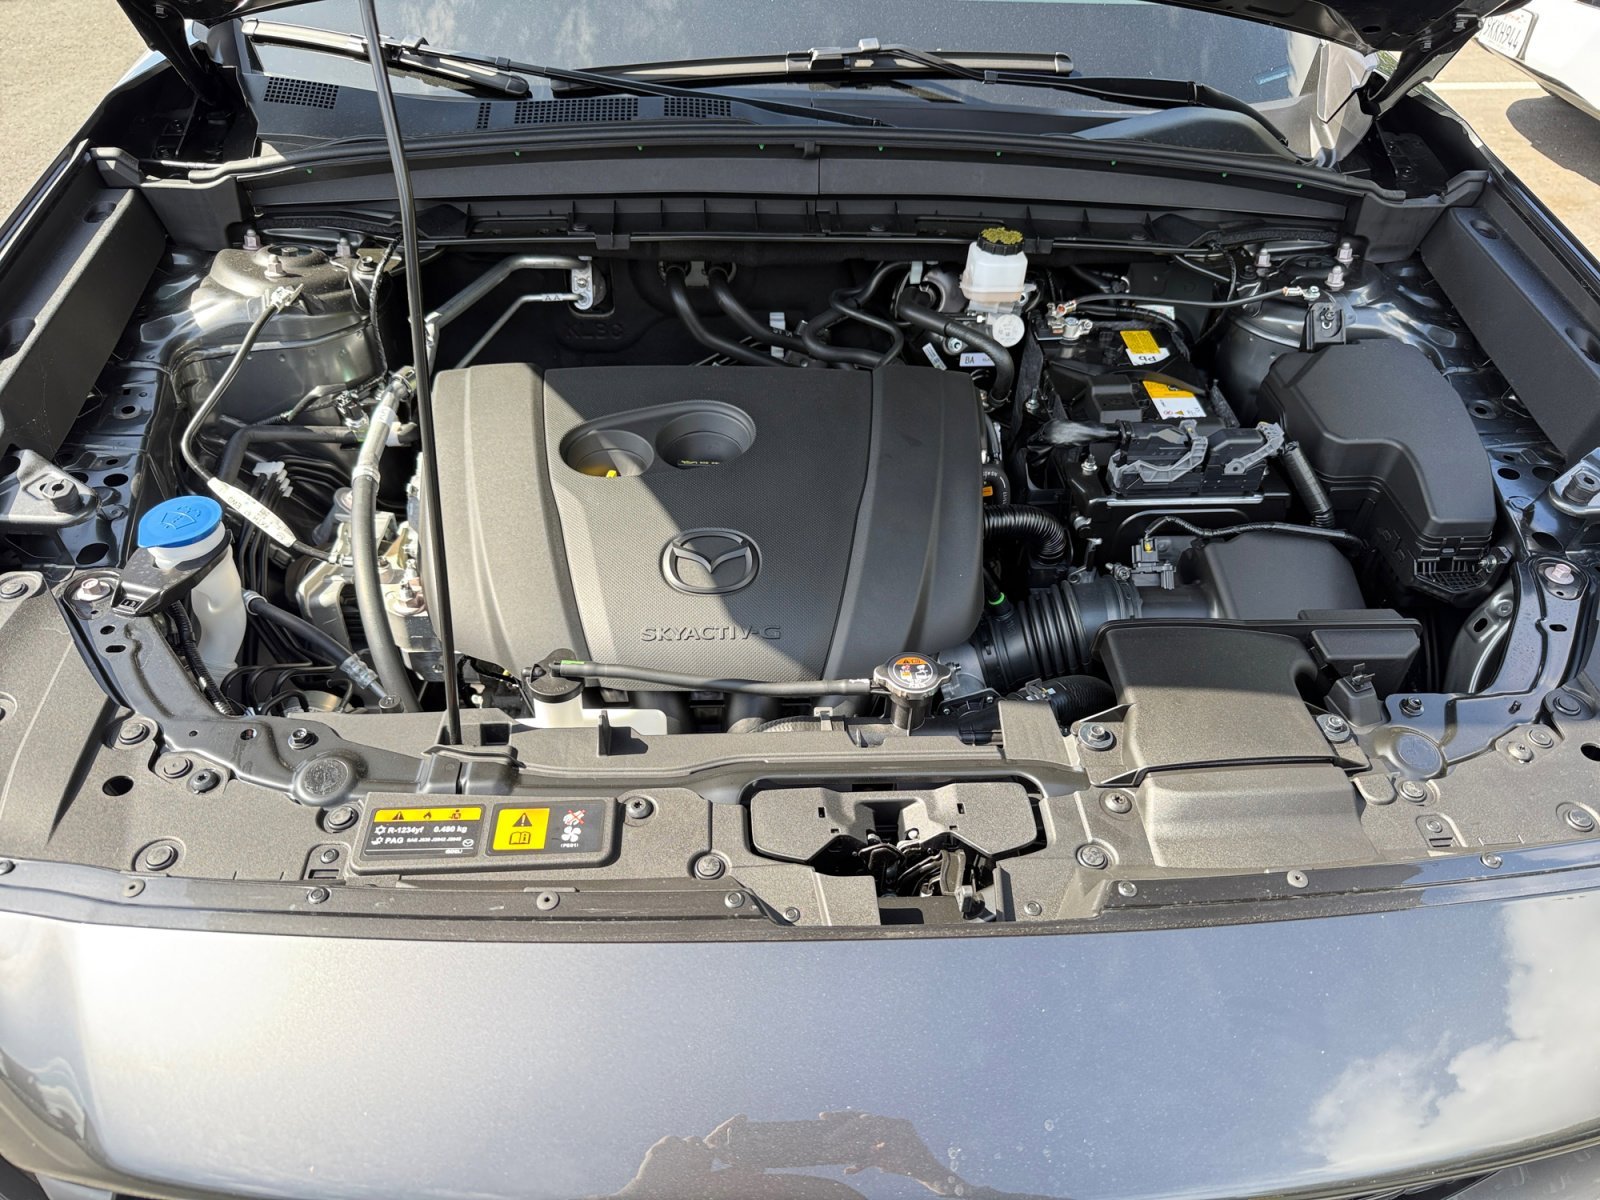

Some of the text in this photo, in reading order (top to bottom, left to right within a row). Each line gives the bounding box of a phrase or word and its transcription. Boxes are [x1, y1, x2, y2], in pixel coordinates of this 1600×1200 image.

[641, 625, 781, 641] SKYACTIV-G
[387, 825, 425, 834] R-1234yf
[456, 825, 468, 834] kg
[384, 836, 404, 845] PAG
